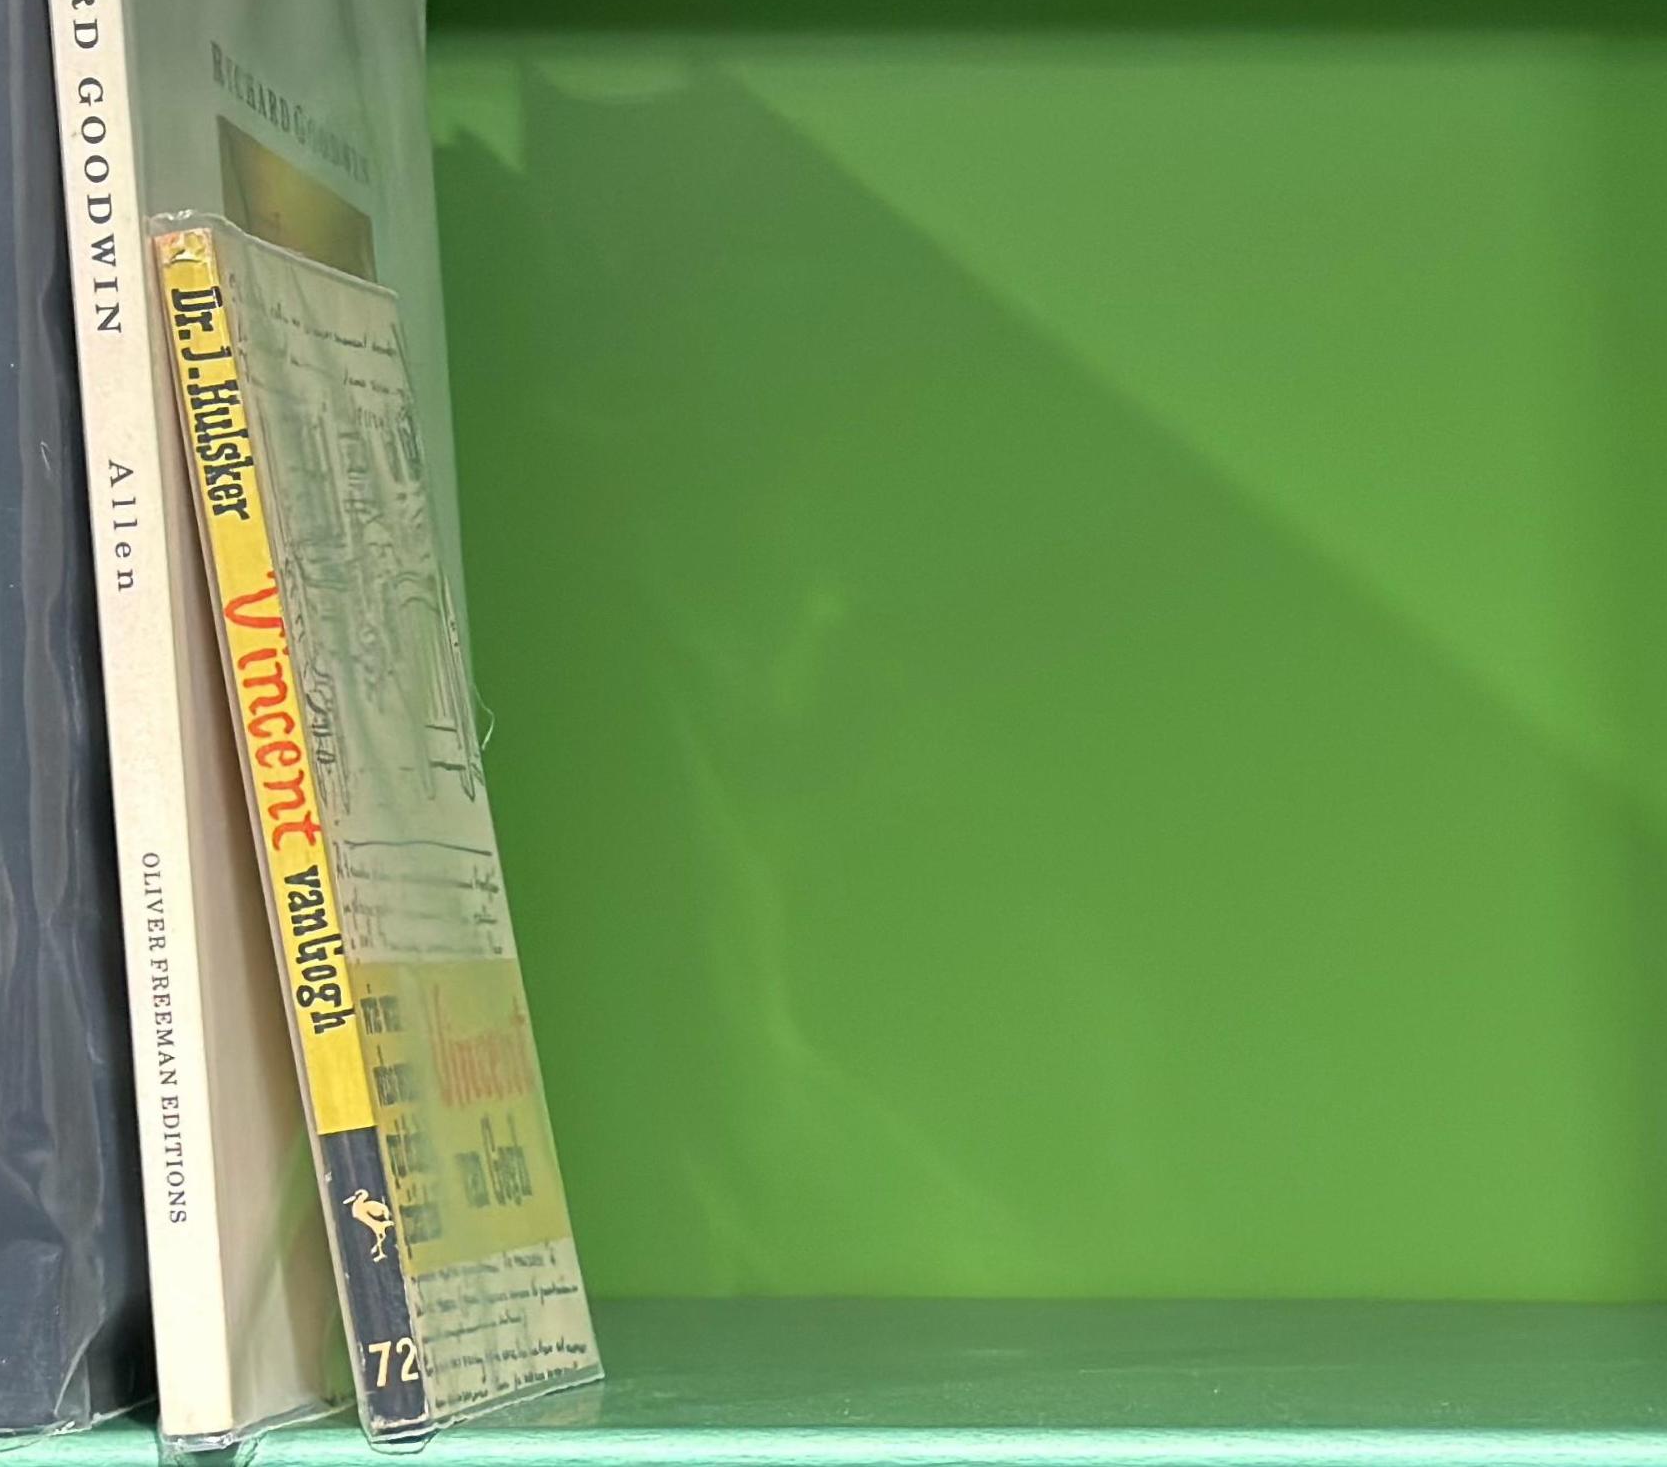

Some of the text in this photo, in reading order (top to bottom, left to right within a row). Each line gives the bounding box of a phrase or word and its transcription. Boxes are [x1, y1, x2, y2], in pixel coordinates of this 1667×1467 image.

[76, 76, 121, 334] GOODWIN
[107, 458, 138, 593] Allen
[224, 570, 323, 852] Vincent
[140, 852, 187, 1226] OLIVER FREEMAN EDITIONS
[368, 1336, 420, 1388] 72
